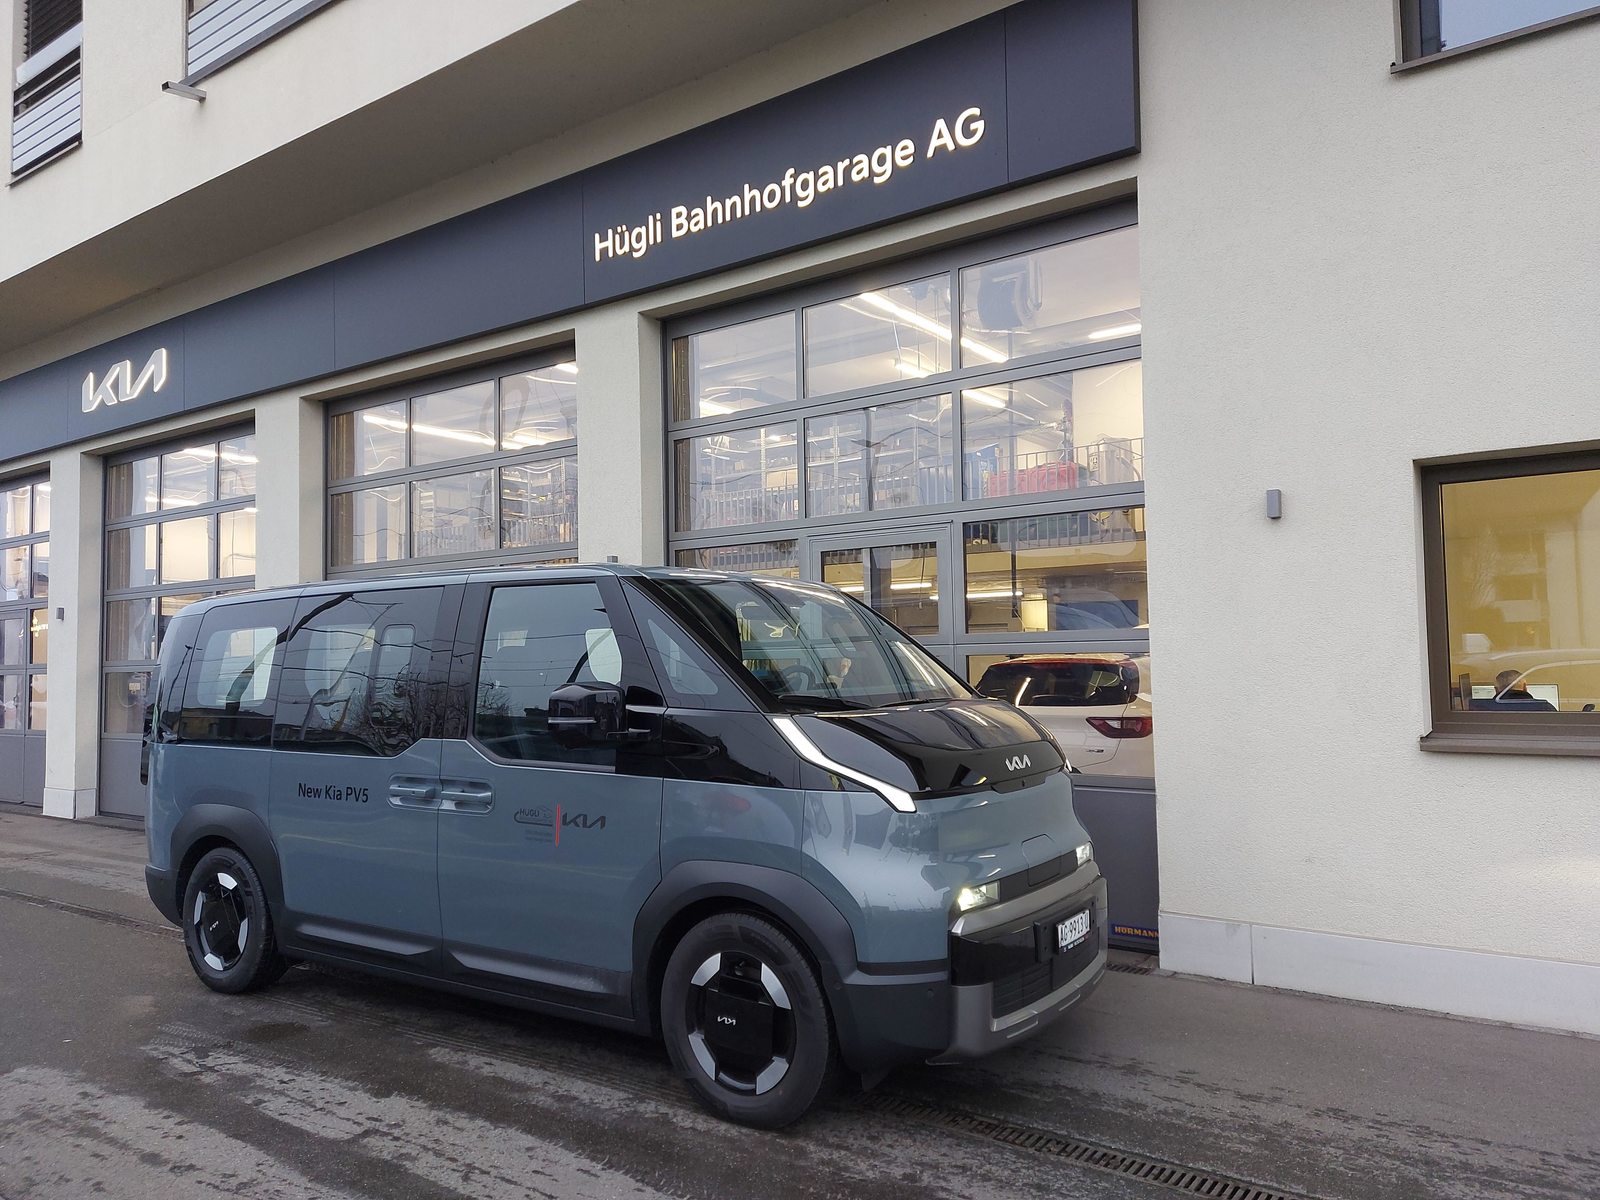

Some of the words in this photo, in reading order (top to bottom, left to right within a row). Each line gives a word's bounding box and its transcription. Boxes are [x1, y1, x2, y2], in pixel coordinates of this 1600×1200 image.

[593, 213, 663, 261] Hügli
[670, 137, 915, 238] Bahnhofgarage
[926, 106, 986, 159] AG
[81, 347, 167, 413] KIA
[1005, 754, 1031, 771] KIA
[298, 782, 322, 798] New
[324, 784, 342, 800] Kia
[345, 786, 369, 803] PV5
[562, 812, 606, 830] KIA
